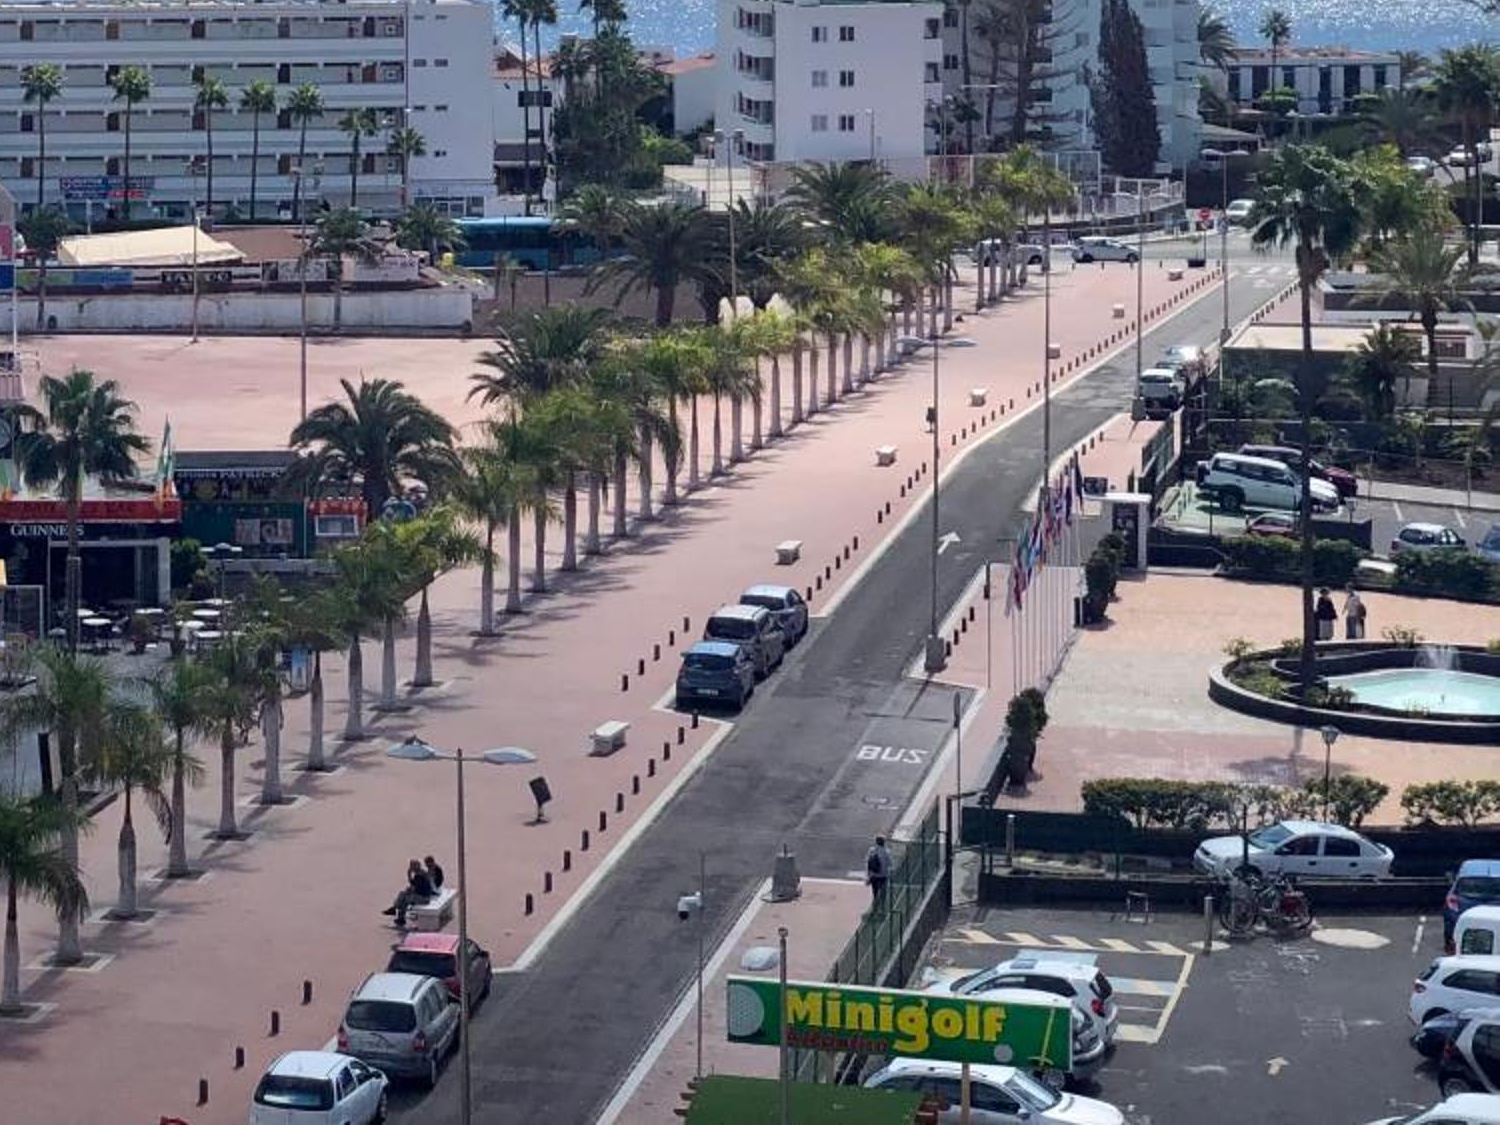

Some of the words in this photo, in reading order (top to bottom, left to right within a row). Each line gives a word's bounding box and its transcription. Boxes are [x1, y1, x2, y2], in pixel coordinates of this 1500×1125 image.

[10, 523, 85, 537] GUINNES
[857, 744, 929, 764] BUS
[786, 988, 1007, 1053] Minigolf
